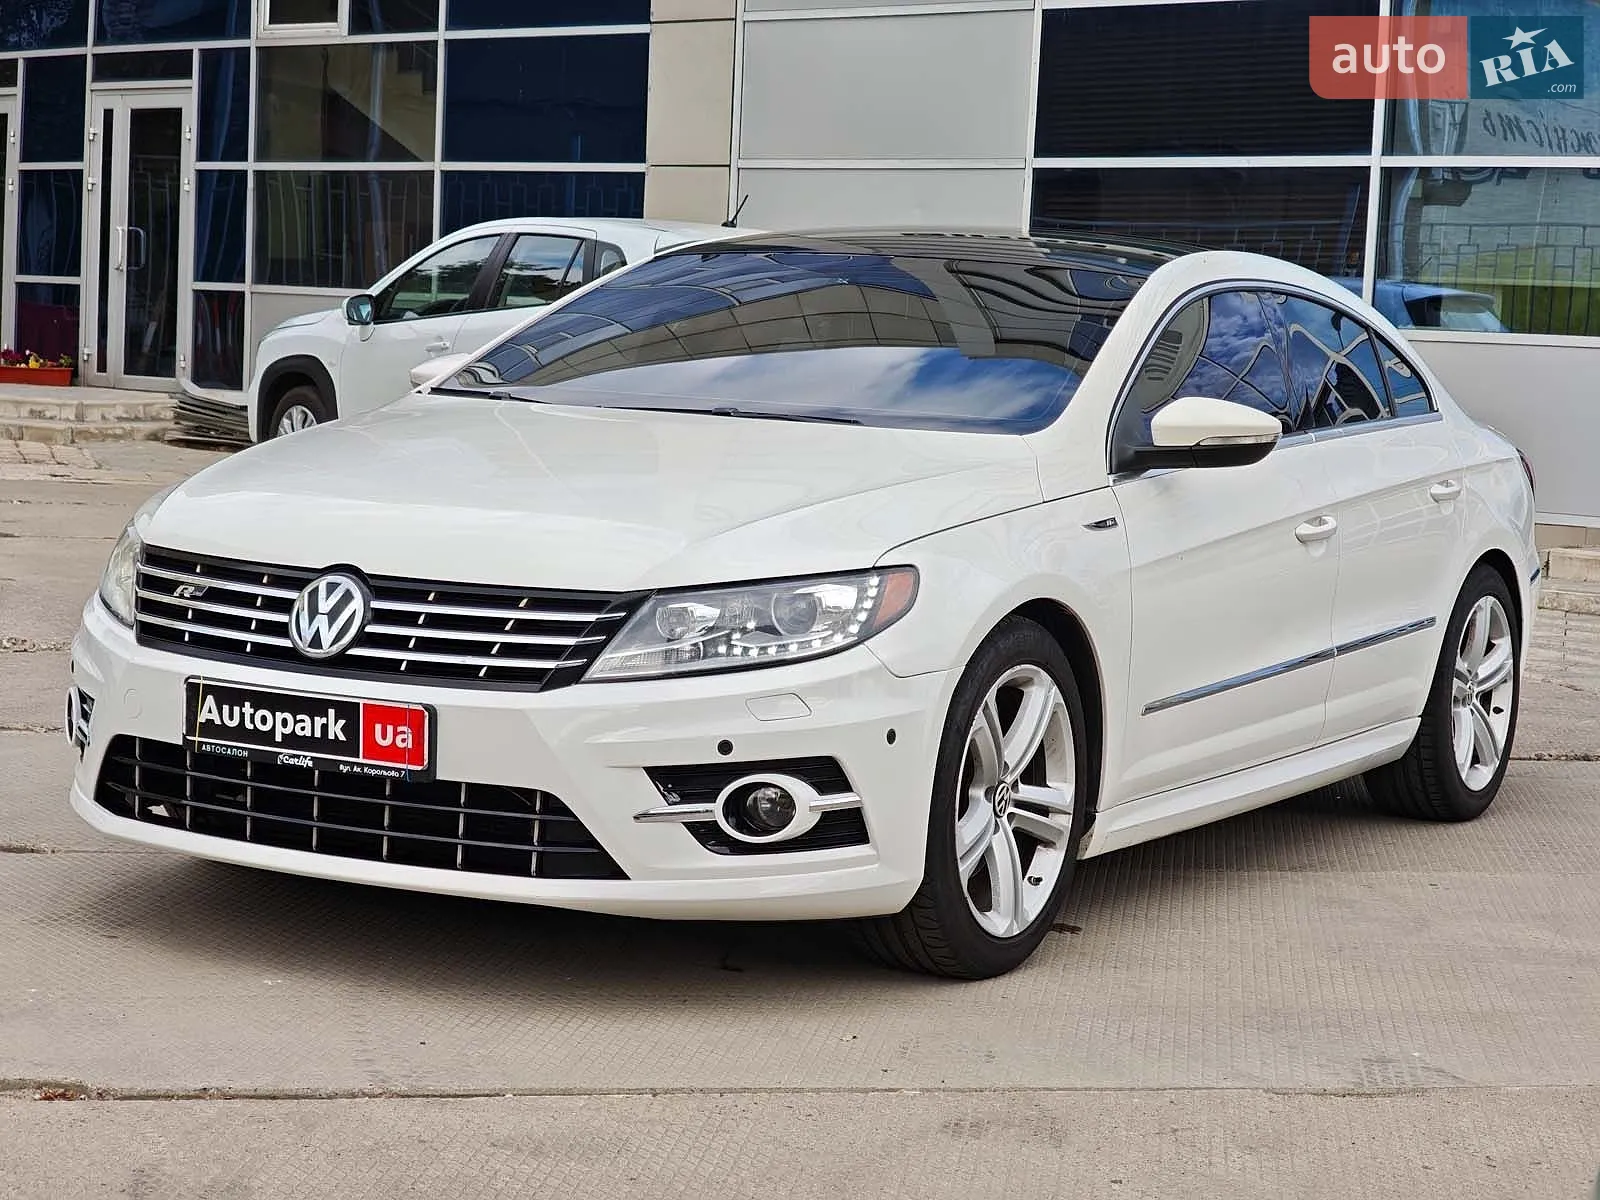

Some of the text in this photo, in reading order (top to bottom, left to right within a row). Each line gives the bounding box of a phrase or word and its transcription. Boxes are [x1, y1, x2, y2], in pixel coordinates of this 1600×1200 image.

[199, 694, 413, 749] Autopark ua
[201, 743, 248, 758] АВТОСАЛОН
[400, 770, 405, 778] 7
